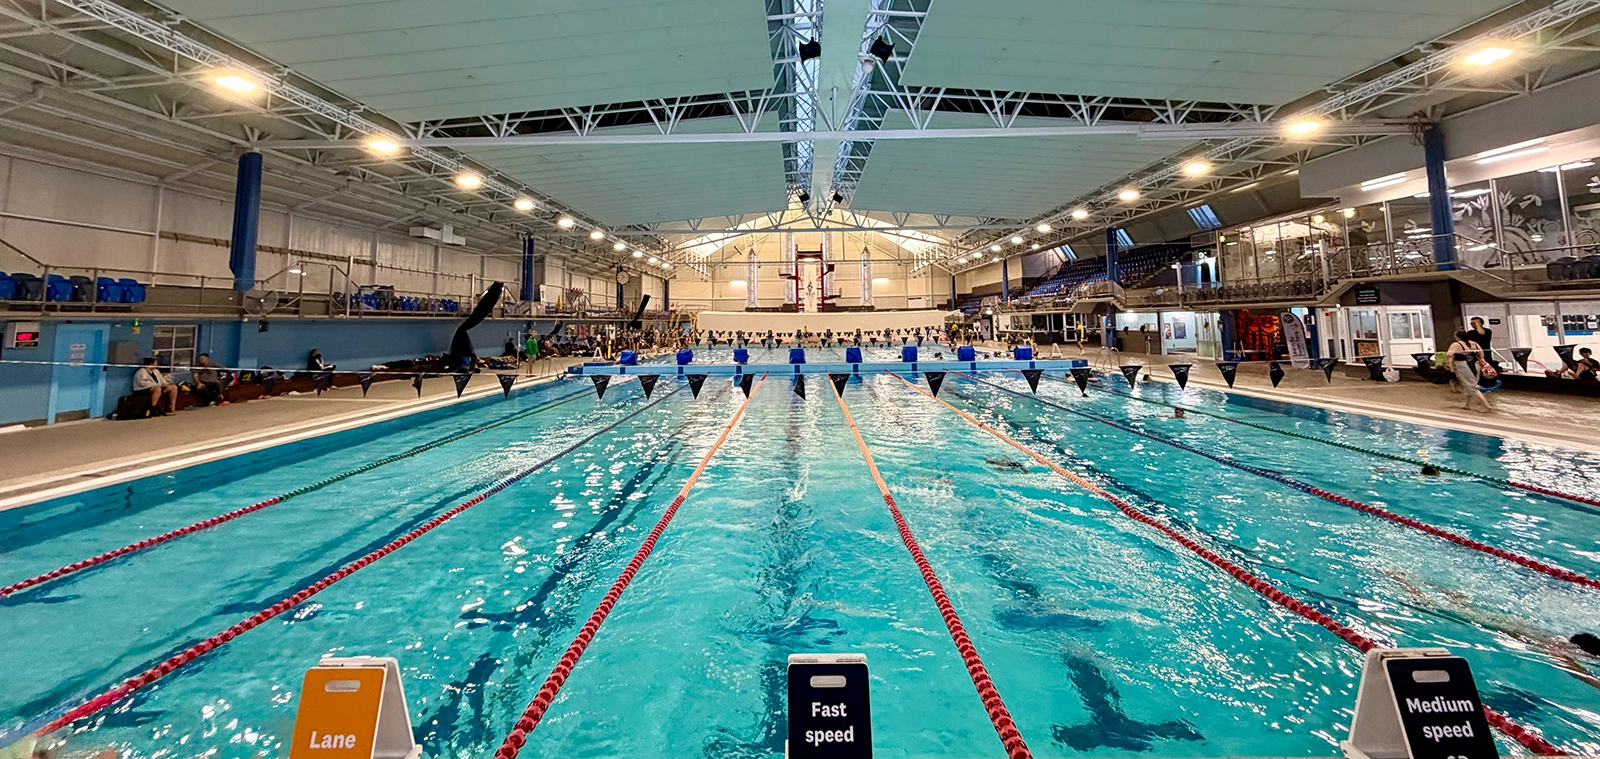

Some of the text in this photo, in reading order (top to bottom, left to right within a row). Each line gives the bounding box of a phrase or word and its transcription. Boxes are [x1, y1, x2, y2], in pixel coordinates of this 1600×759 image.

[811, 701, 847, 717] Fast
[1405, 696, 1475, 713] Medium
[309, 731, 356, 749] Lane
[805, 725, 854, 747] speed
[1422, 720, 1475, 743] speed
